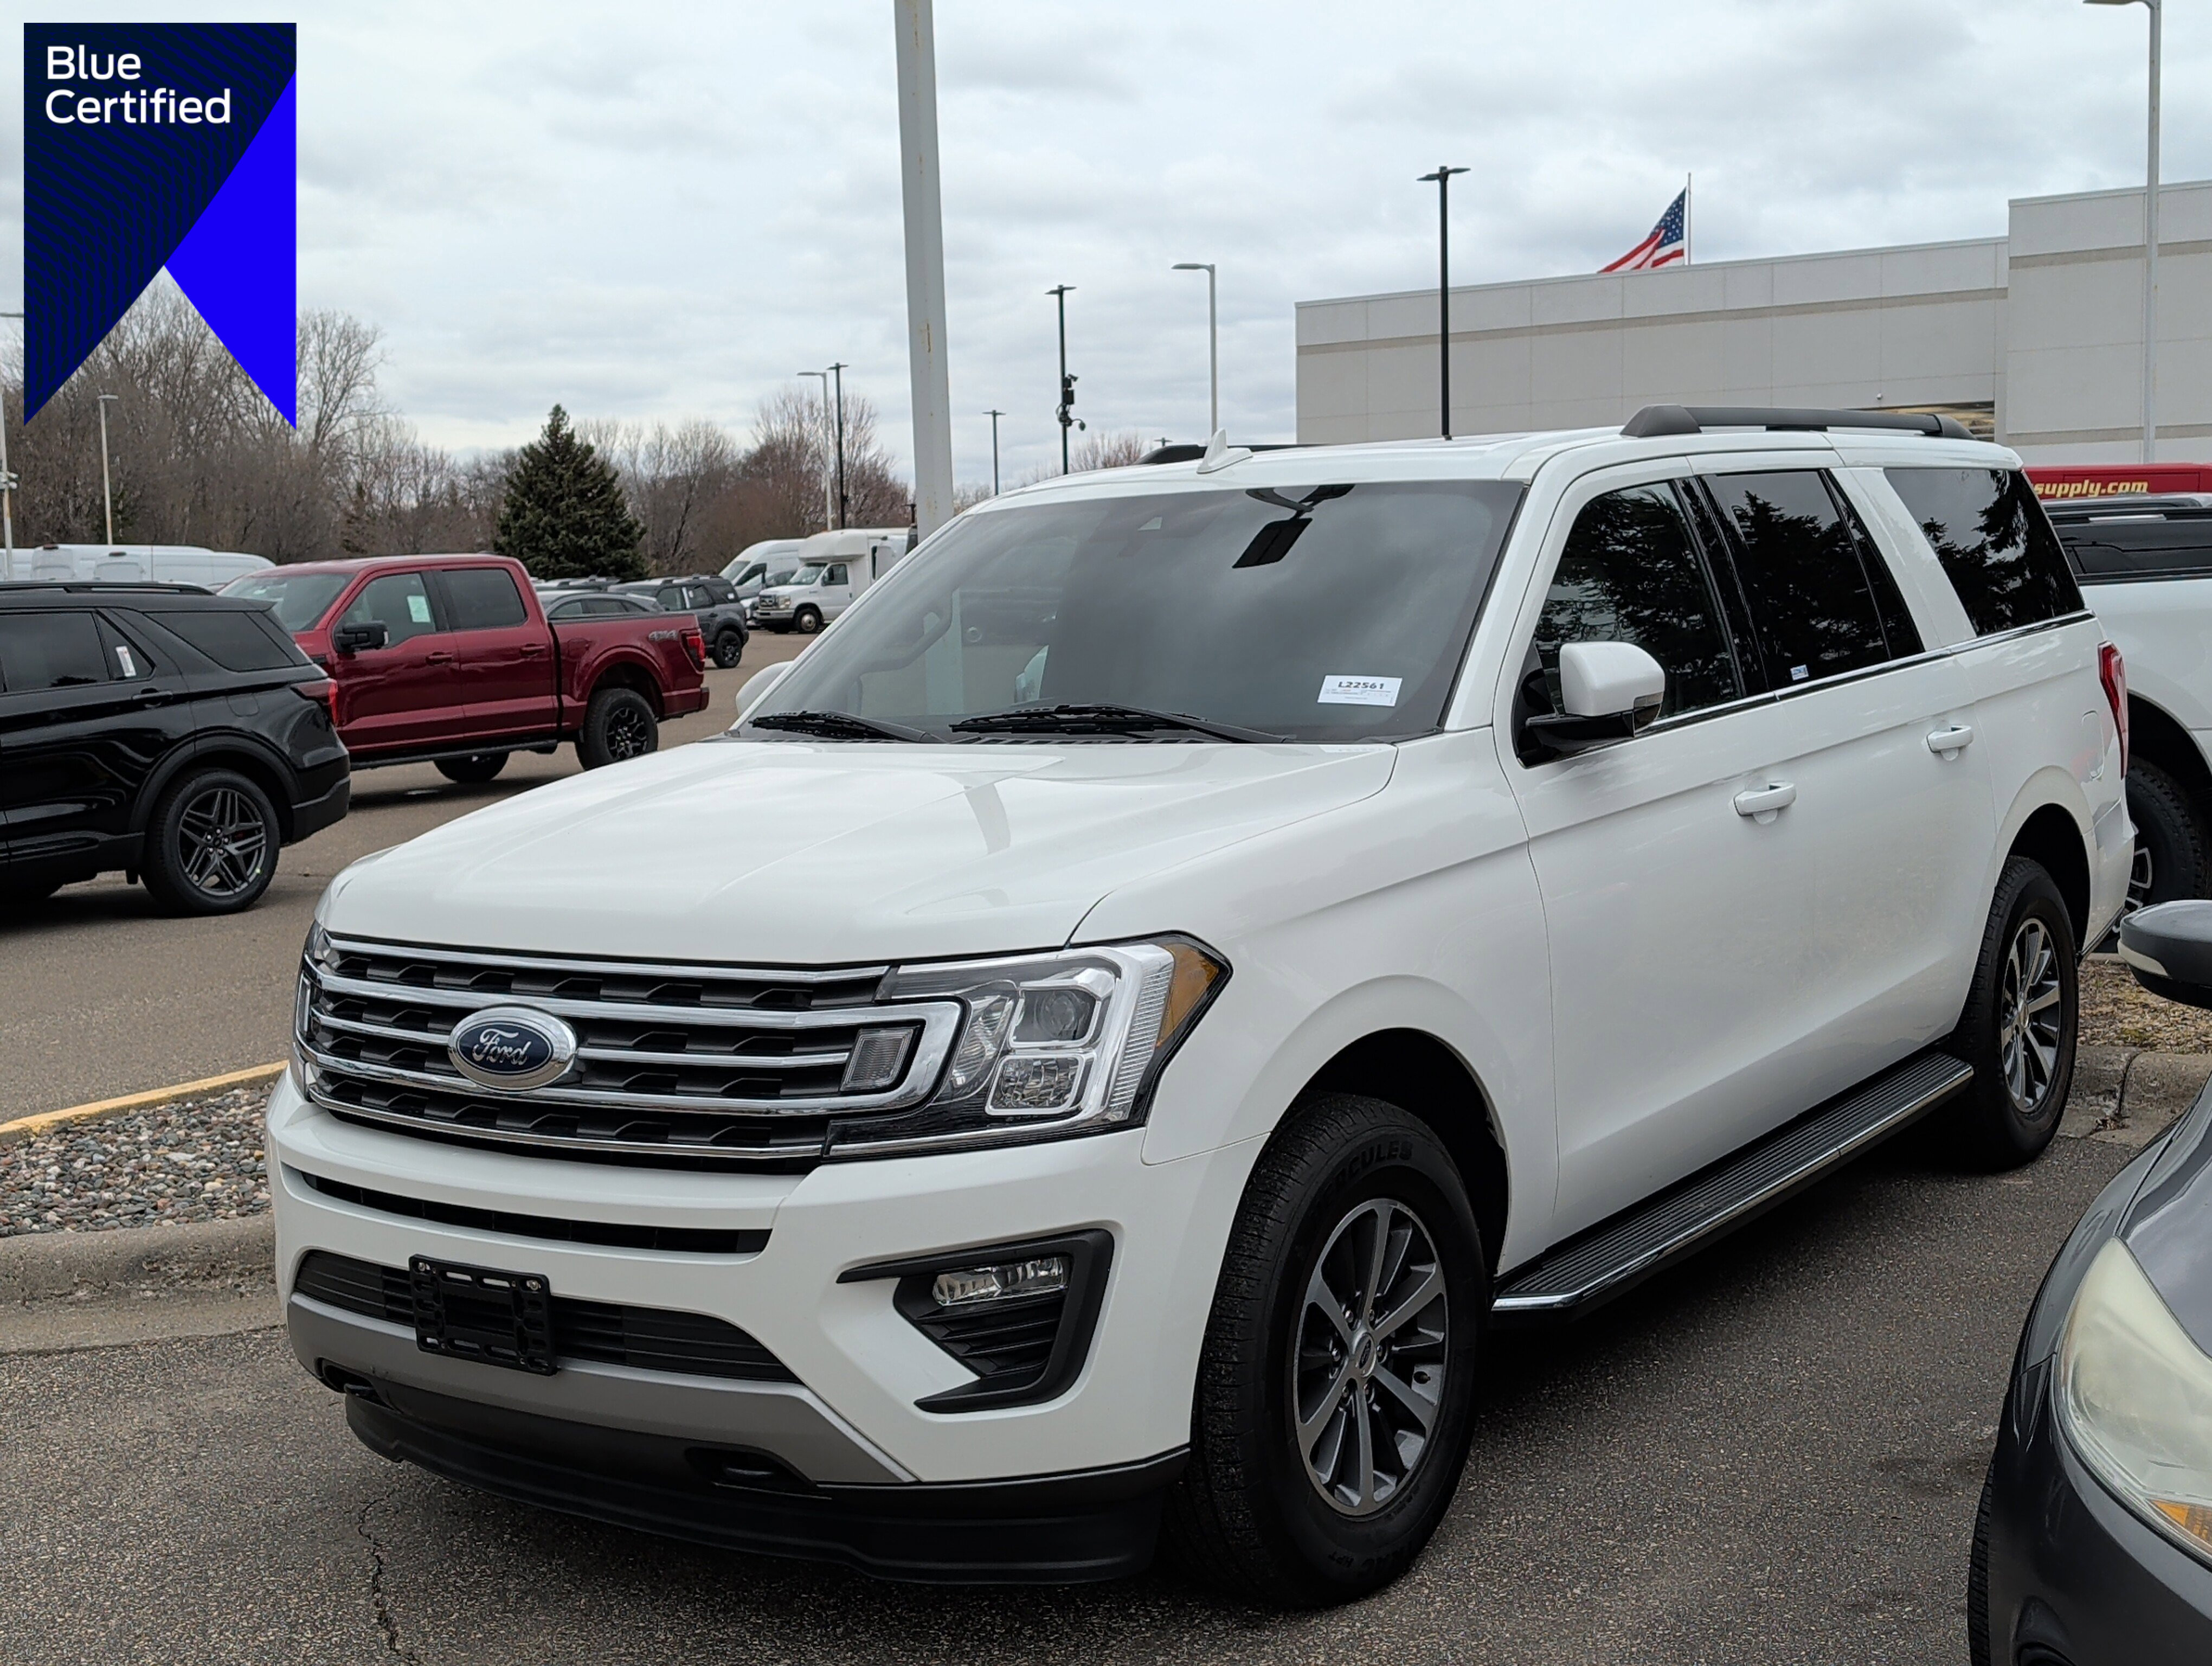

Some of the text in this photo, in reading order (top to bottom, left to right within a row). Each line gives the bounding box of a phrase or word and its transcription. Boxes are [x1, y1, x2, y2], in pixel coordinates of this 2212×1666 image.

[2034, 479, 2149, 498] supply.com
[1338, 681, 1384, 689] L22561
[472, 1028, 531, 1066] Ford
